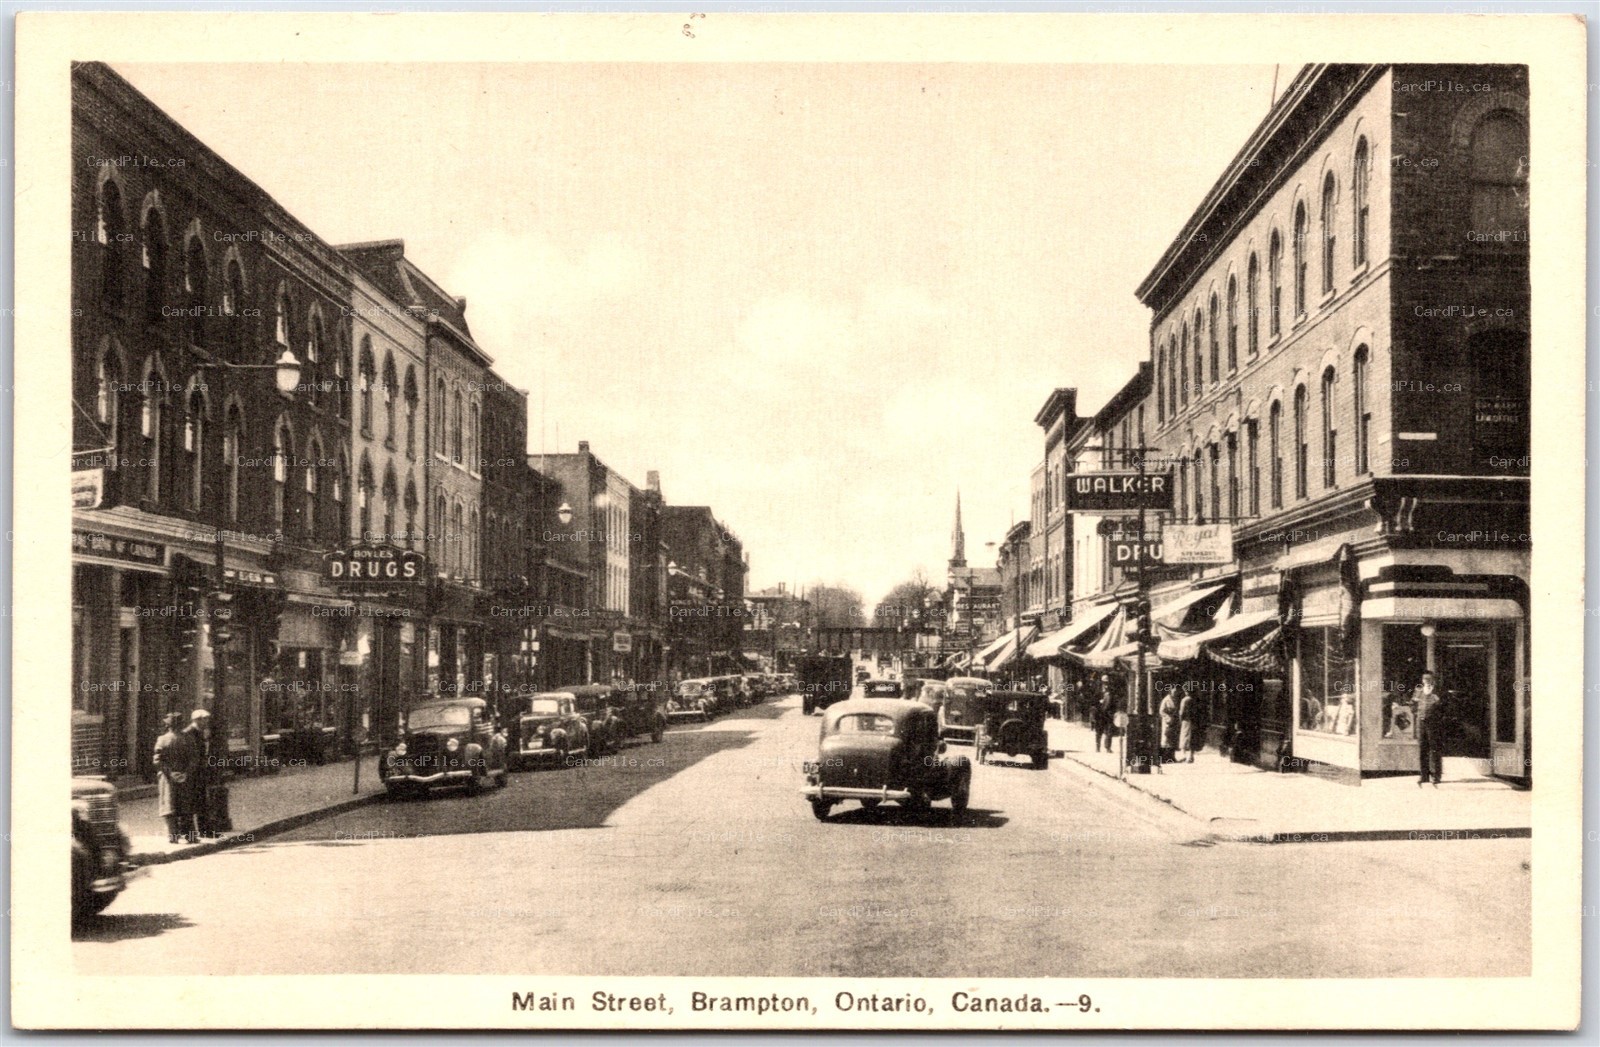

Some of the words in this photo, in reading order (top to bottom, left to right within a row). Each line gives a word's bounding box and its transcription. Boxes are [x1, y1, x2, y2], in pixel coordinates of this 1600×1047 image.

[1076, 476, 1165, 494] WALKER
[1172, 525, 1220, 549] Royal
[353, 550, 394, 558] BOYLES
[331, 561, 416, 577] DRUGS
[956, 602, 1001, 611] RESAURANT
